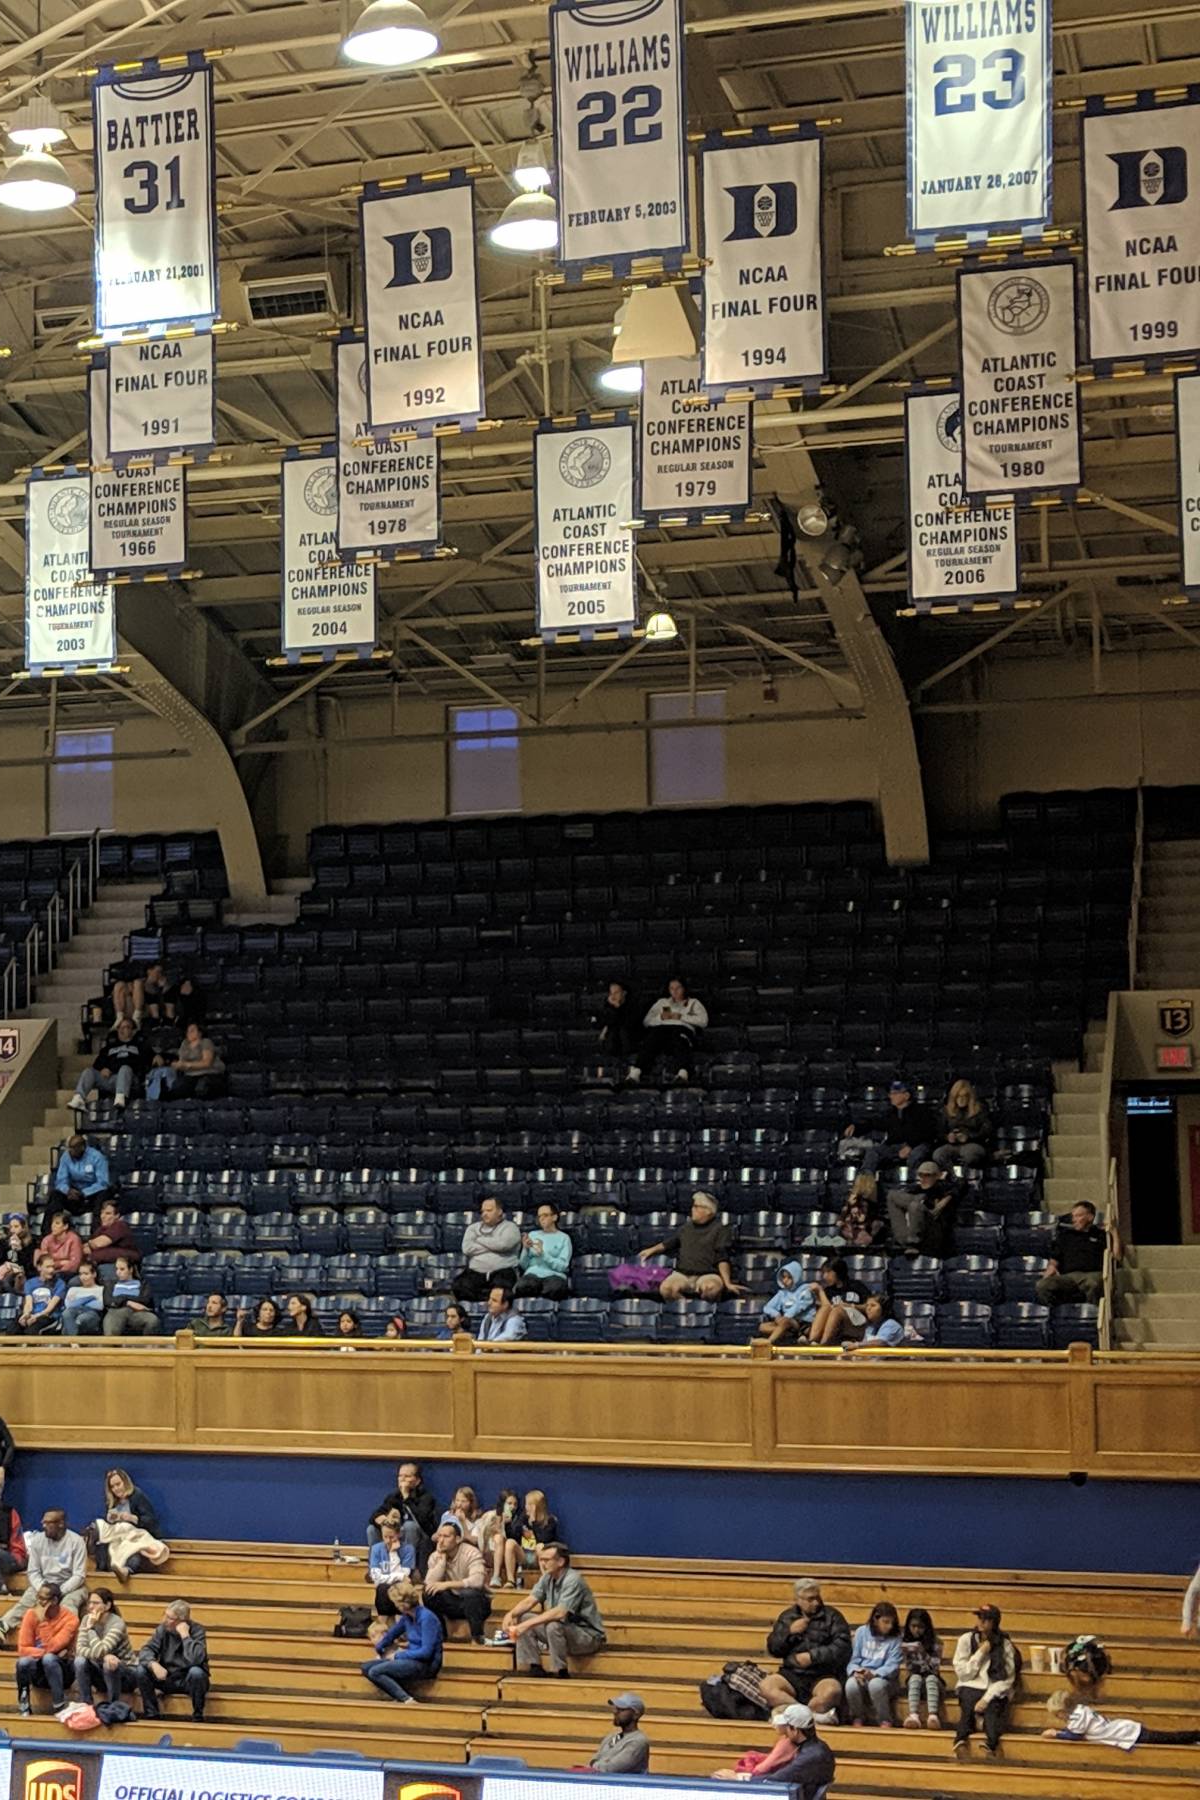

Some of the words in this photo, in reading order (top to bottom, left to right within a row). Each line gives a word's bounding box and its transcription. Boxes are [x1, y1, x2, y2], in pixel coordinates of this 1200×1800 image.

[921, 0, 1036, 44] WILLIAMS
[564, 33, 671, 82] WILLIAMS
[933, 48, 1026, 117] 23
[577, 84, 663, 151] 22
[106, 108, 200, 152] BATTIER
[123, 155, 185, 214] 31
[921, 175, 982, 195] JANUARY
[568, 206, 631, 228] FEBRUARY
[635, 200, 677, 219] 5,2003
[1125, 235, 1177, 258] NCAA
[739, 265, 788, 286] NCAA
[1095, 272, 1150, 294] FINAL
[1157, 265, 1200, 287] FOU
[711, 299, 762, 321] FINAL
[768, 294, 818, 313] FOUR
[399, 309, 444, 331] NCAA
[1129, 320, 1178, 342] 1999
[139, 342, 182, 361] NCAA
[374, 343, 421, 365] FINAL
[427, 335, 473, 358] FOUR
[741, 347, 786, 367] 1994
[981, 351, 1057, 373] ATLANTIC
[115, 373, 159, 393] FINAL
[164, 369, 208, 388] FOUR
[660, 378, 705, 396] ATLA
[993, 373, 1047, 393] COAST
[403, 386, 445, 408] 1992
[671, 399, 719, 414] COAST
[968, 391, 1073, 417] CONFERENCE
[142, 417, 180, 436] 1991
[646, 415, 746, 437] CONFERENCE
[973, 413, 1070, 436] CHAMPIONS
[650, 435, 742, 456] CHAMPIONS
[989, 439, 1053, 454] TOURNAMENT
[343, 455, 434, 477] CONFERENCE
[657, 463, 697, 474] REGULAR
[700, 459, 734, 471] SEASON
[999, 460, 1045, 479] 1980
[94, 478, 181, 499] CONFERENCE
[346, 474, 430, 495] CHAMPIONS
[675, 480, 717, 497] 1979
[927, 473, 962, 489] ATLA
[98, 498, 177, 517] CHAMPIONS
[359, 499, 415, 512] TOURNAMENT
[938, 491, 969, 507] COA
[103, 518, 139, 529] REGULAR
[141, 515, 171, 526] SEASON
[552, 503, 617, 522] ATLANTIC
[914, 507, 1012, 529] CONFERENCE
[111, 527, 164, 540] TOURNAMENT
[368, 518, 407, 536] 1978
[563, 523, 607, 539] COAST
[919, 526, 1008, 547] CHAMPIONS
[299, 530, 337, 547] ATLAN
[119, 541, 156, 557] 1966
[308, 549, 343, 564] COAS
[542, 539, 630, 560] CONFERENCE
[927, 545, 966, 558] REGULAR
[968, 543, 1002, 555] SEASON
[43, 552, 89, 567] ATLANTI
[546, 558, 627, 579] CHAMPIONS
[934, 555, 993, 568] TOURNAMENT
[50, 569, 88, 583] COAST
[288, 563, 371, 583] CONFERENCE
[944, 568, 985, 587] 2006
[33, 584, 109, 602] CONFERENCE
[291, 581, 368, 600] CHAMPIONS
[559, 581, 612, 593] TOURNAMENT
[36, 600, 105, 618] CHAMPIONS
[332, 603, 362, 613] SEASON
[567, 599, 606, 616] 2005
[311, 621, 347, 637] 2004
[57, 638, 85, 652] 2003
[1163, 1009, 1188, 1030] 13
[115, 1786, 183, 1800] OFFICIAL
